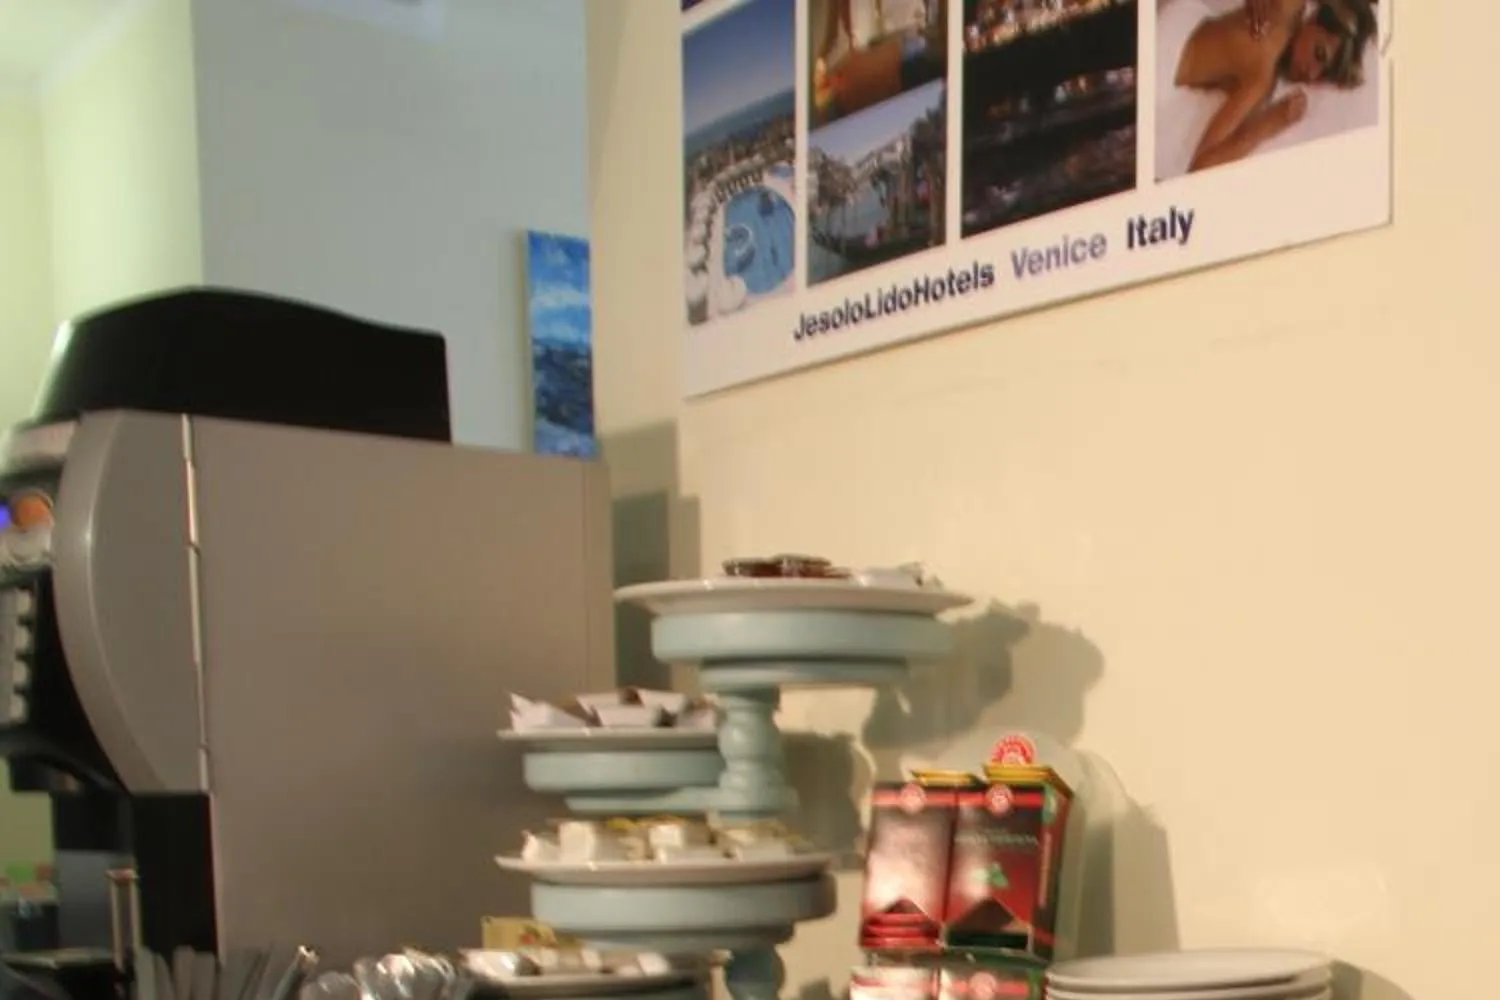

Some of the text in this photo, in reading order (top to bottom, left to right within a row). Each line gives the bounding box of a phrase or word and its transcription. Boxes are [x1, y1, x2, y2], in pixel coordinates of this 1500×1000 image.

[793, 205, 1195, 340] JesoloLidoHotels Venice Italy
